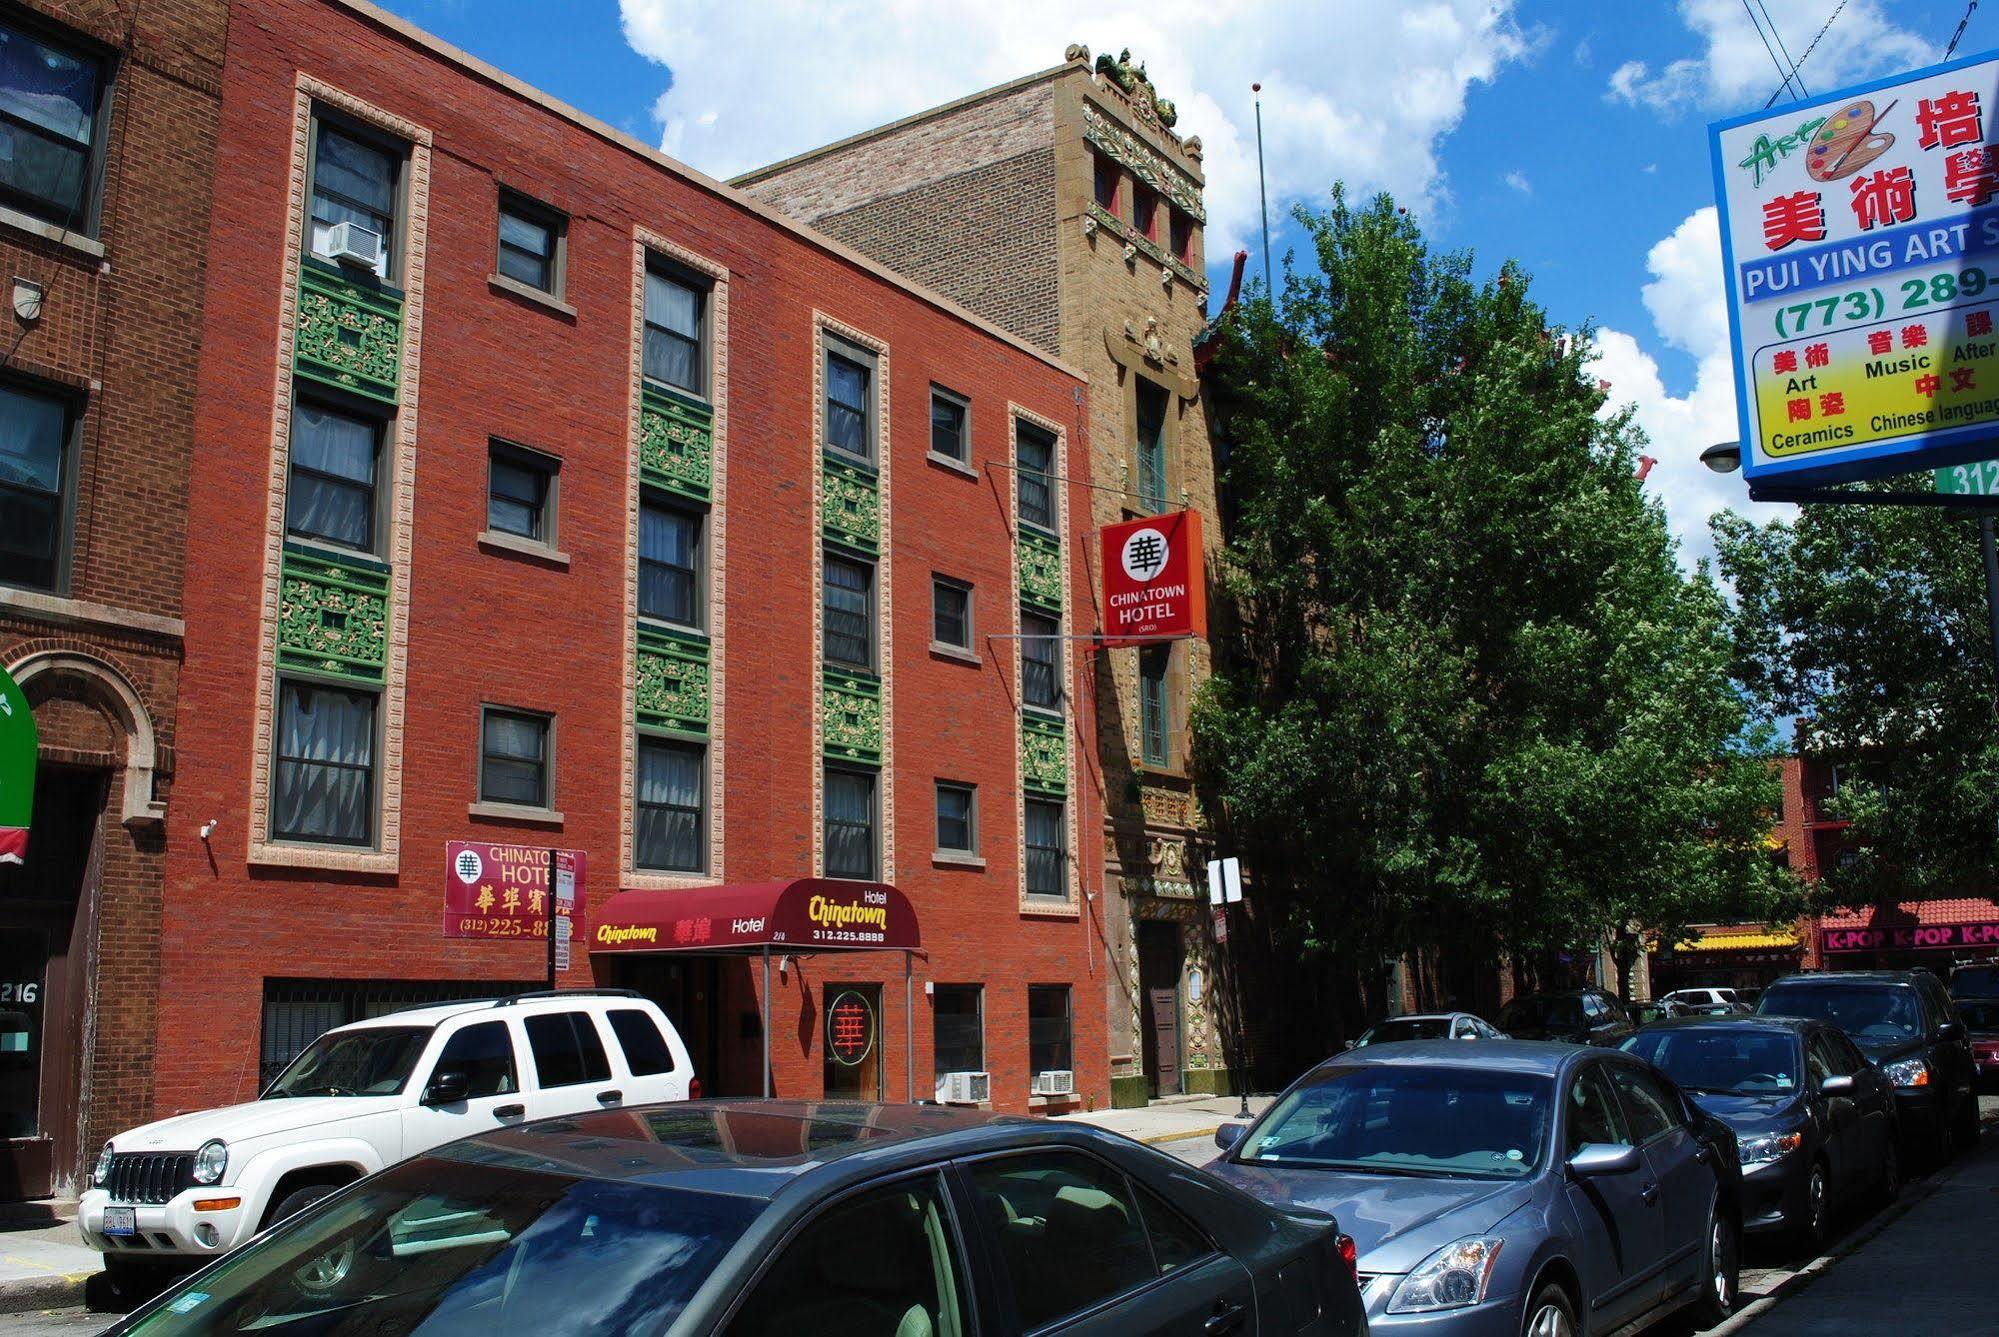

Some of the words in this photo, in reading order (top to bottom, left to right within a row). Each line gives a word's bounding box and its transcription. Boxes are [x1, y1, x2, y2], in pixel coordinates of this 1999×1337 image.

[1915, 90, 1983, 151] 培
[1746, 261, 1800, 296] PUI
[1809, 241, 1893, 281] YING
[1904, 223, 1970, 263] ART
[1775, 288, 1885, 339] (773)
[1868, 324, 1928, 355] 音樂
[1773, 342, 1829, 375] 美術
[1953, 342, 1996, 362] After
[1865, 355, 1930, 379] Music
[1786, 375, 1817, 394] Art
[1915, 367, 1976, 398] 中文
[1871, 410, 1934, 432] Chinese
[1772, 425, 1854, 449] Ceramics
[1110, 585, 1185, 607] CHINATOWN
[1120, 603, 1175, 624] HOTEL
[1139, 624, 1157, 633] (SRO)
[490, 847, 550, 865] CHINATO
[502, 864, 550, 885] HOTE
[864, 890, 887, 904] Hotel
[809, 895, 887, 930] Chinatown
[597, 924, 657, 944] Chinatown
[732, 917, 765, 933] Hotel
[813, 930, 884, 942] 312.225.8888
[1828, 932, 1885, 949] K-POP
[1895, 927, 1953, 946] K-POP
[1, 983, 38, 1003] 216
